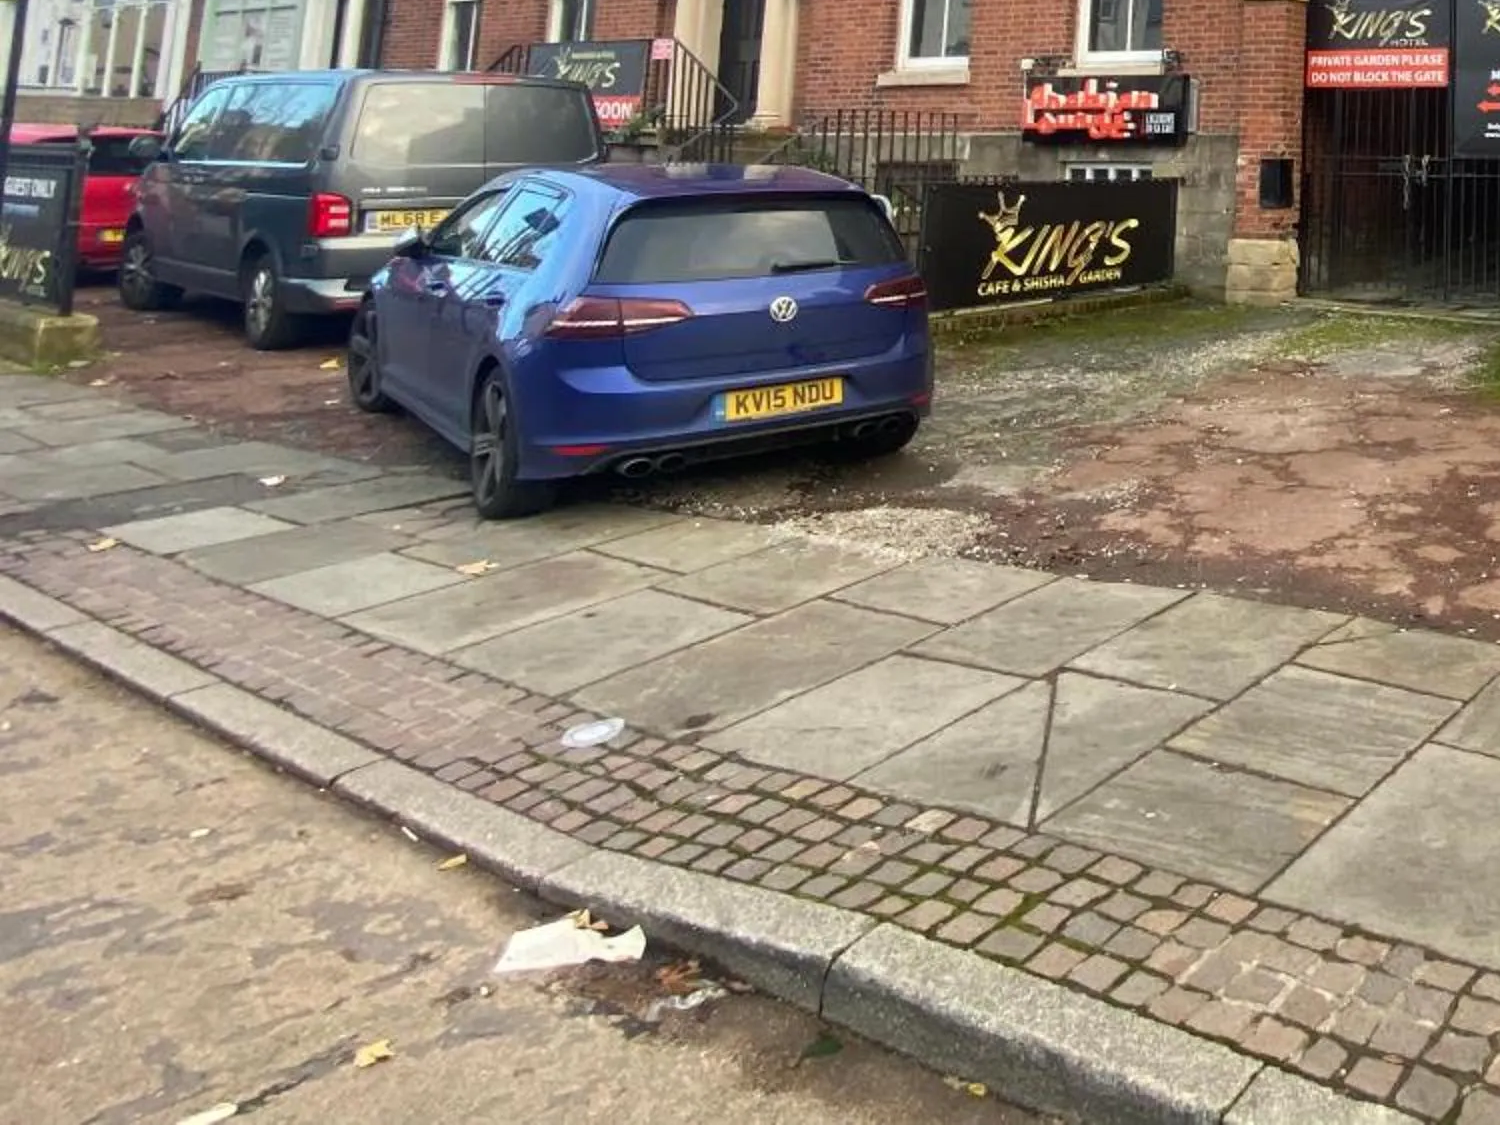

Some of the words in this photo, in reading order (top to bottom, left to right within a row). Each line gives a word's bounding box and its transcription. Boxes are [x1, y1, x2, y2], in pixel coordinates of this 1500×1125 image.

[1327, 8, 1432, 47] KING'S
[1389, 38, 1429, 47] HOTEL
[1310, 56, 1352, 66] PRIVATE
[1353, 55, 1399, 66] GARDEN
[1401, 54, 1444, 66] PLEASE
[1311, 72, 1328, 83] DO
[1330, 71, 1352, 82] NOT
[1354, 71, 1390, 82] BLOCK
[1391, 71, 1412, 82] THE
[1414, 70, 1444, 82] GATE
[982, 218, 1140, 286] KING'S
[977, 280, 1010, 297] CAFE
[1011, 280, 1022, 293] &
[1023, 276, 1066, 291] SHISHA
[1079, 269, 1122, 284] GARDEN
[735, 388, 787, 415] KV15
[793, 380, 835, 406] NDU
